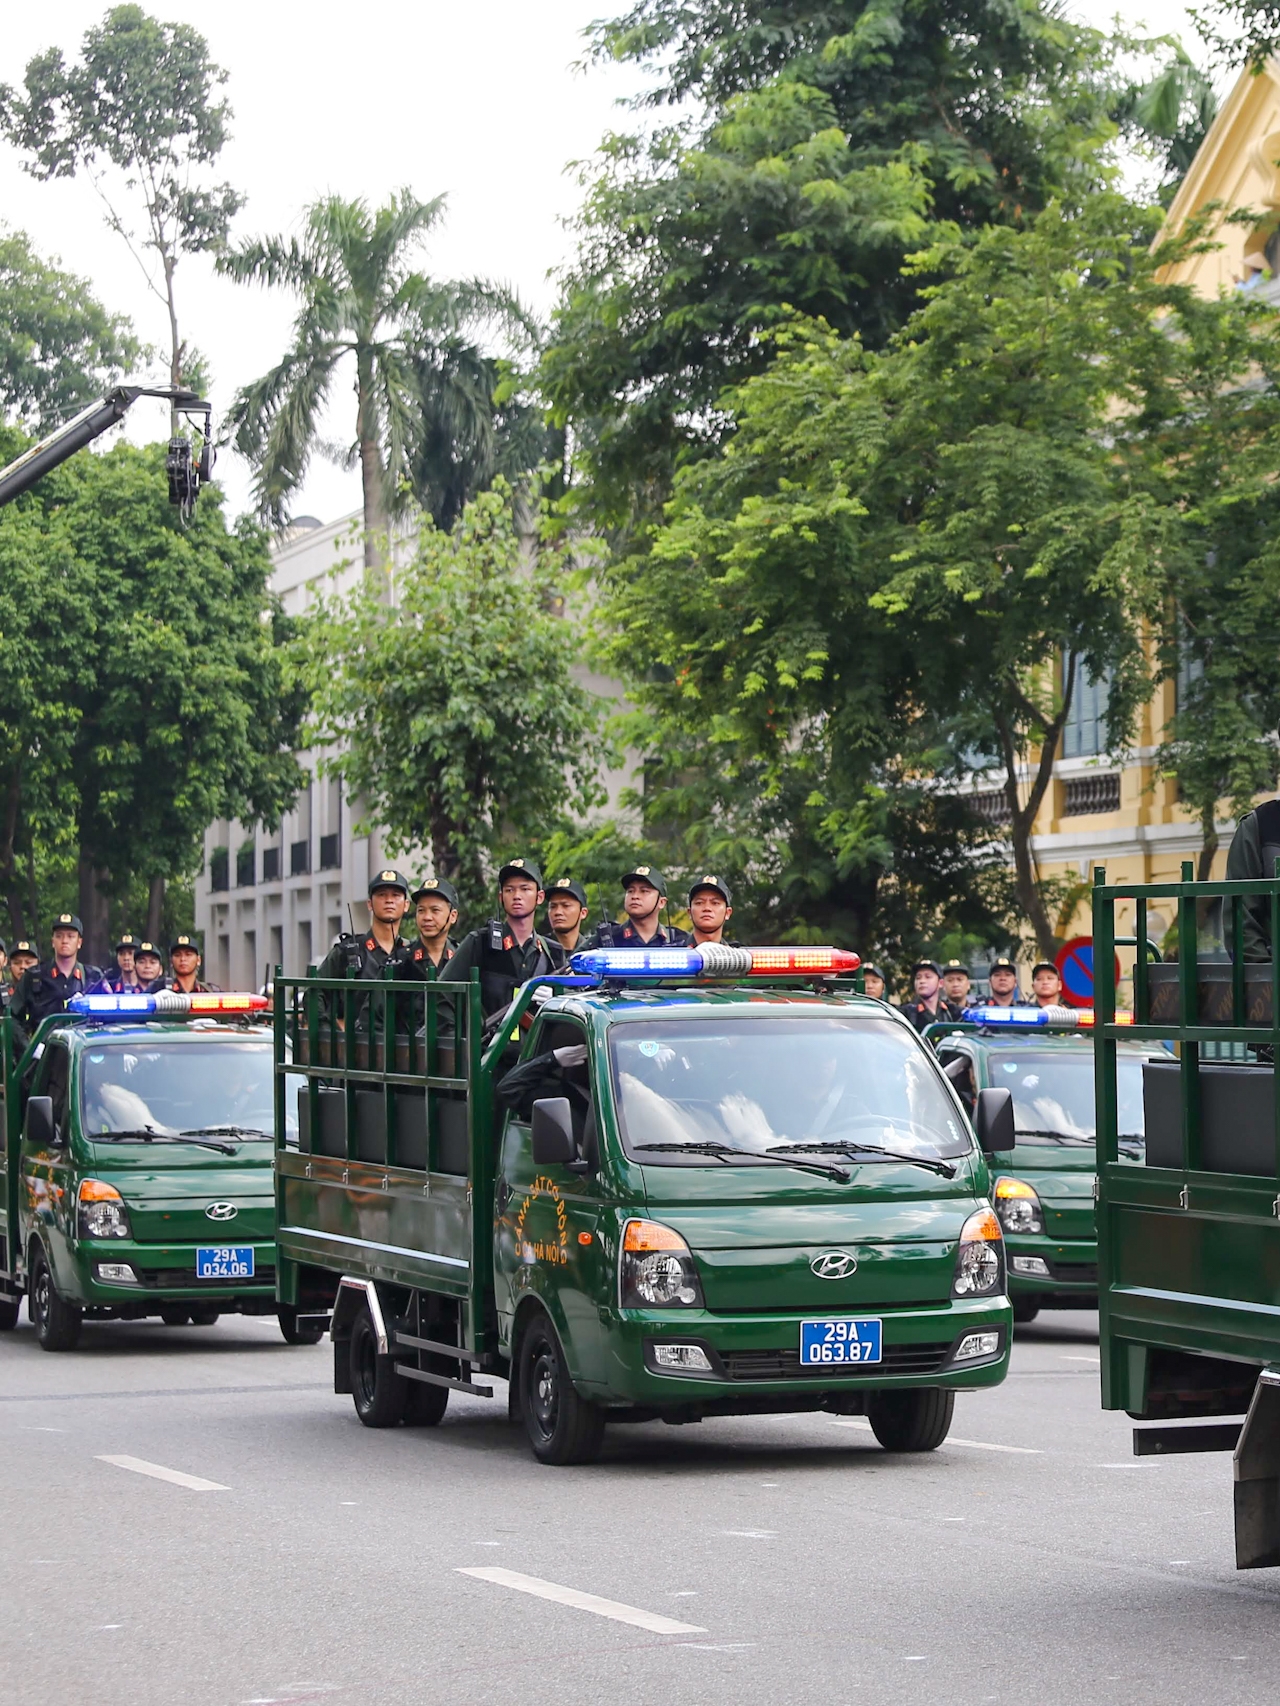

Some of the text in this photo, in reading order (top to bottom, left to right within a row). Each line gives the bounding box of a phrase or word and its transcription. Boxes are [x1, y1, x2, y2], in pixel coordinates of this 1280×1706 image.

[529, 1174, 546, 1200] SÁT
[213, 1249, 238, 1262] 29A
[534, 1239, 545, 1260] HÀ
[546, 1241, 560, 1266] NỘI
[203, 1262, 248, 1276] 034.06
[824, 1322, 859, 1342] 29A
[809, 1342, 873, 1362] 063.87
